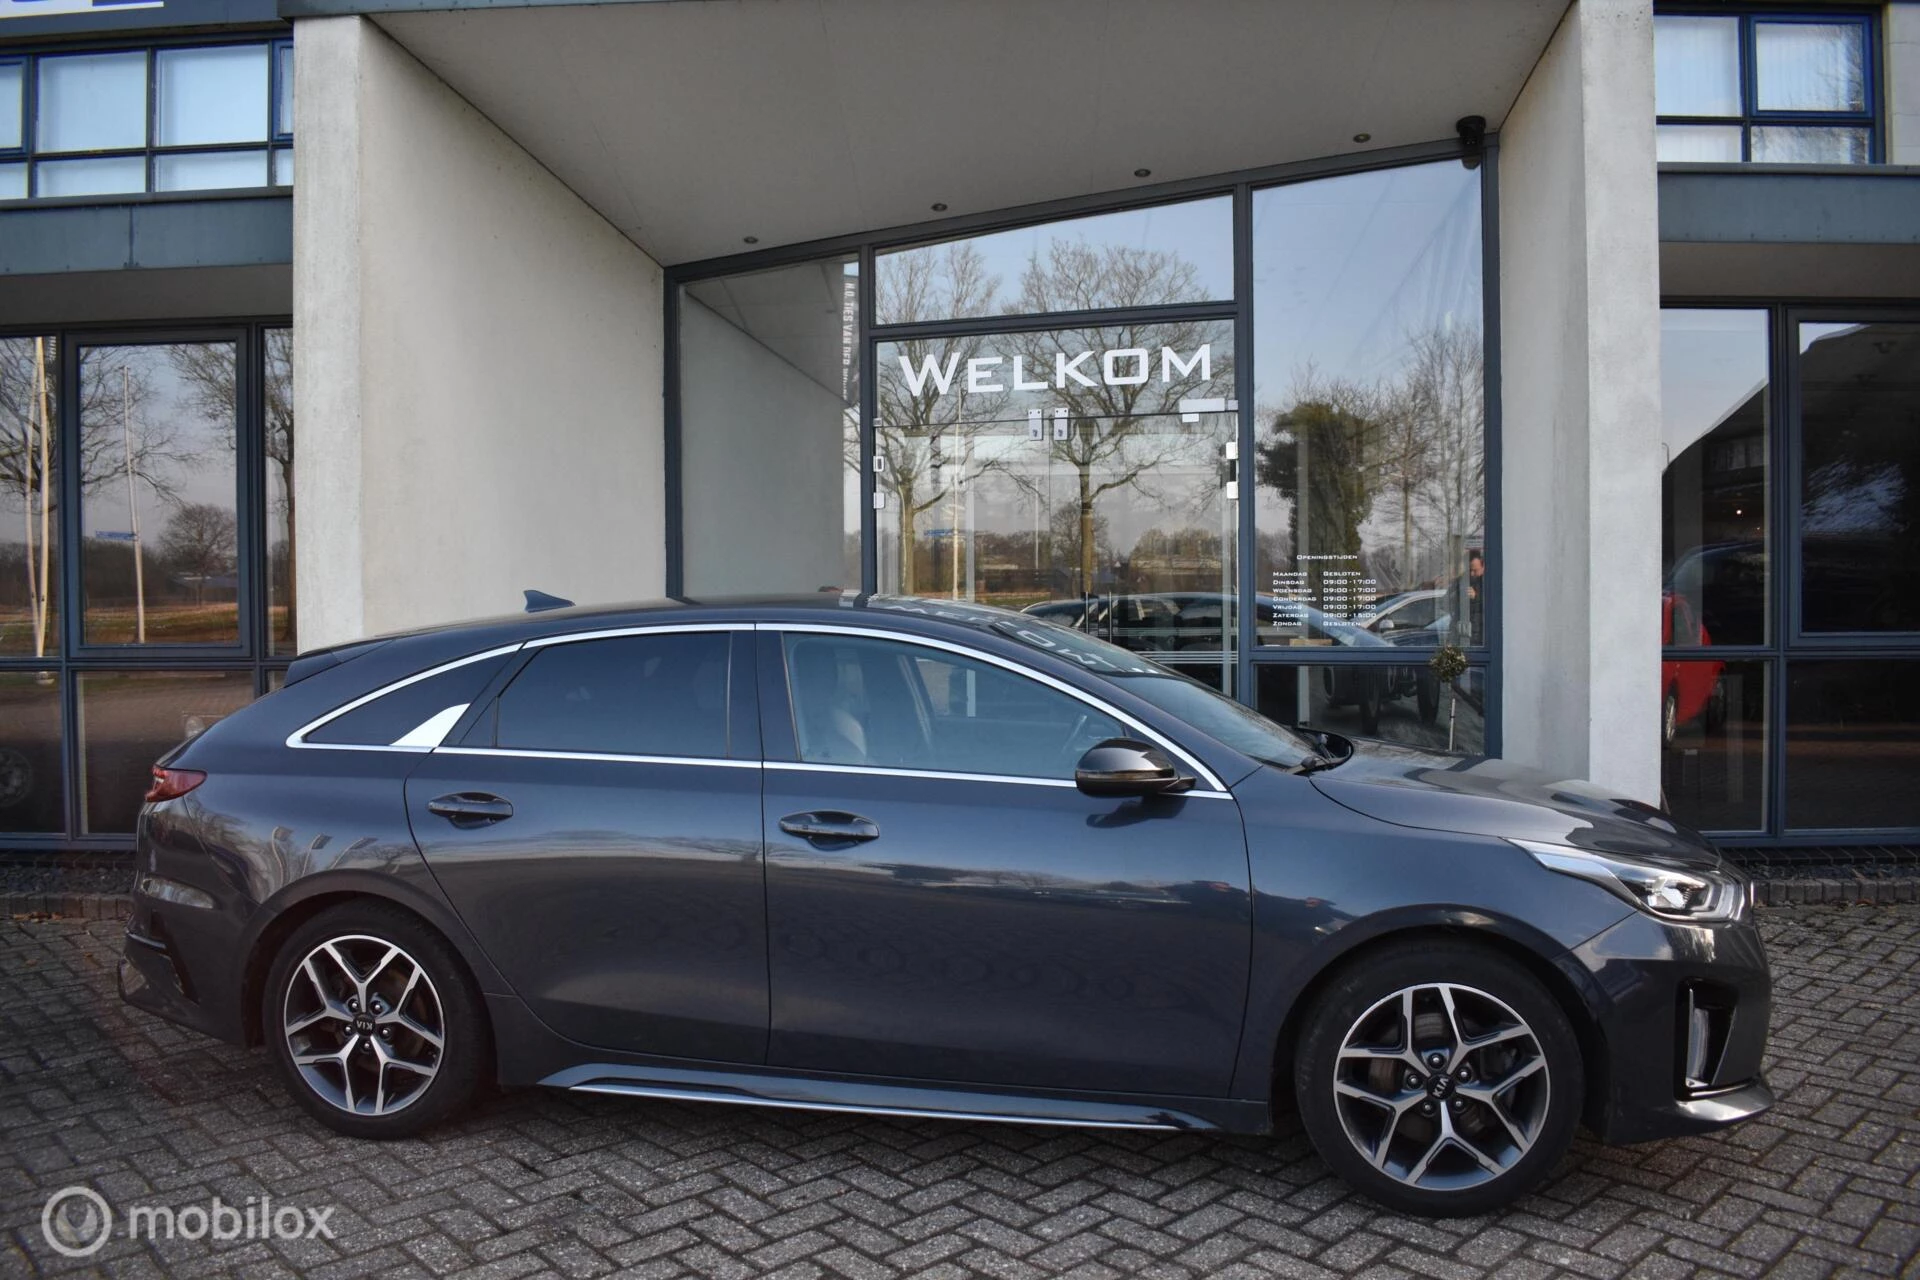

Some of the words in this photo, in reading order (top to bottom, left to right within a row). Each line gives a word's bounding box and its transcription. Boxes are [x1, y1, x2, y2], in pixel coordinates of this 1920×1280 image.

[843, 324, 852, 344] VAN
[899, 344, 1212, 397] WELKOM
[1432, 1077, 1450, 1098] KIA
